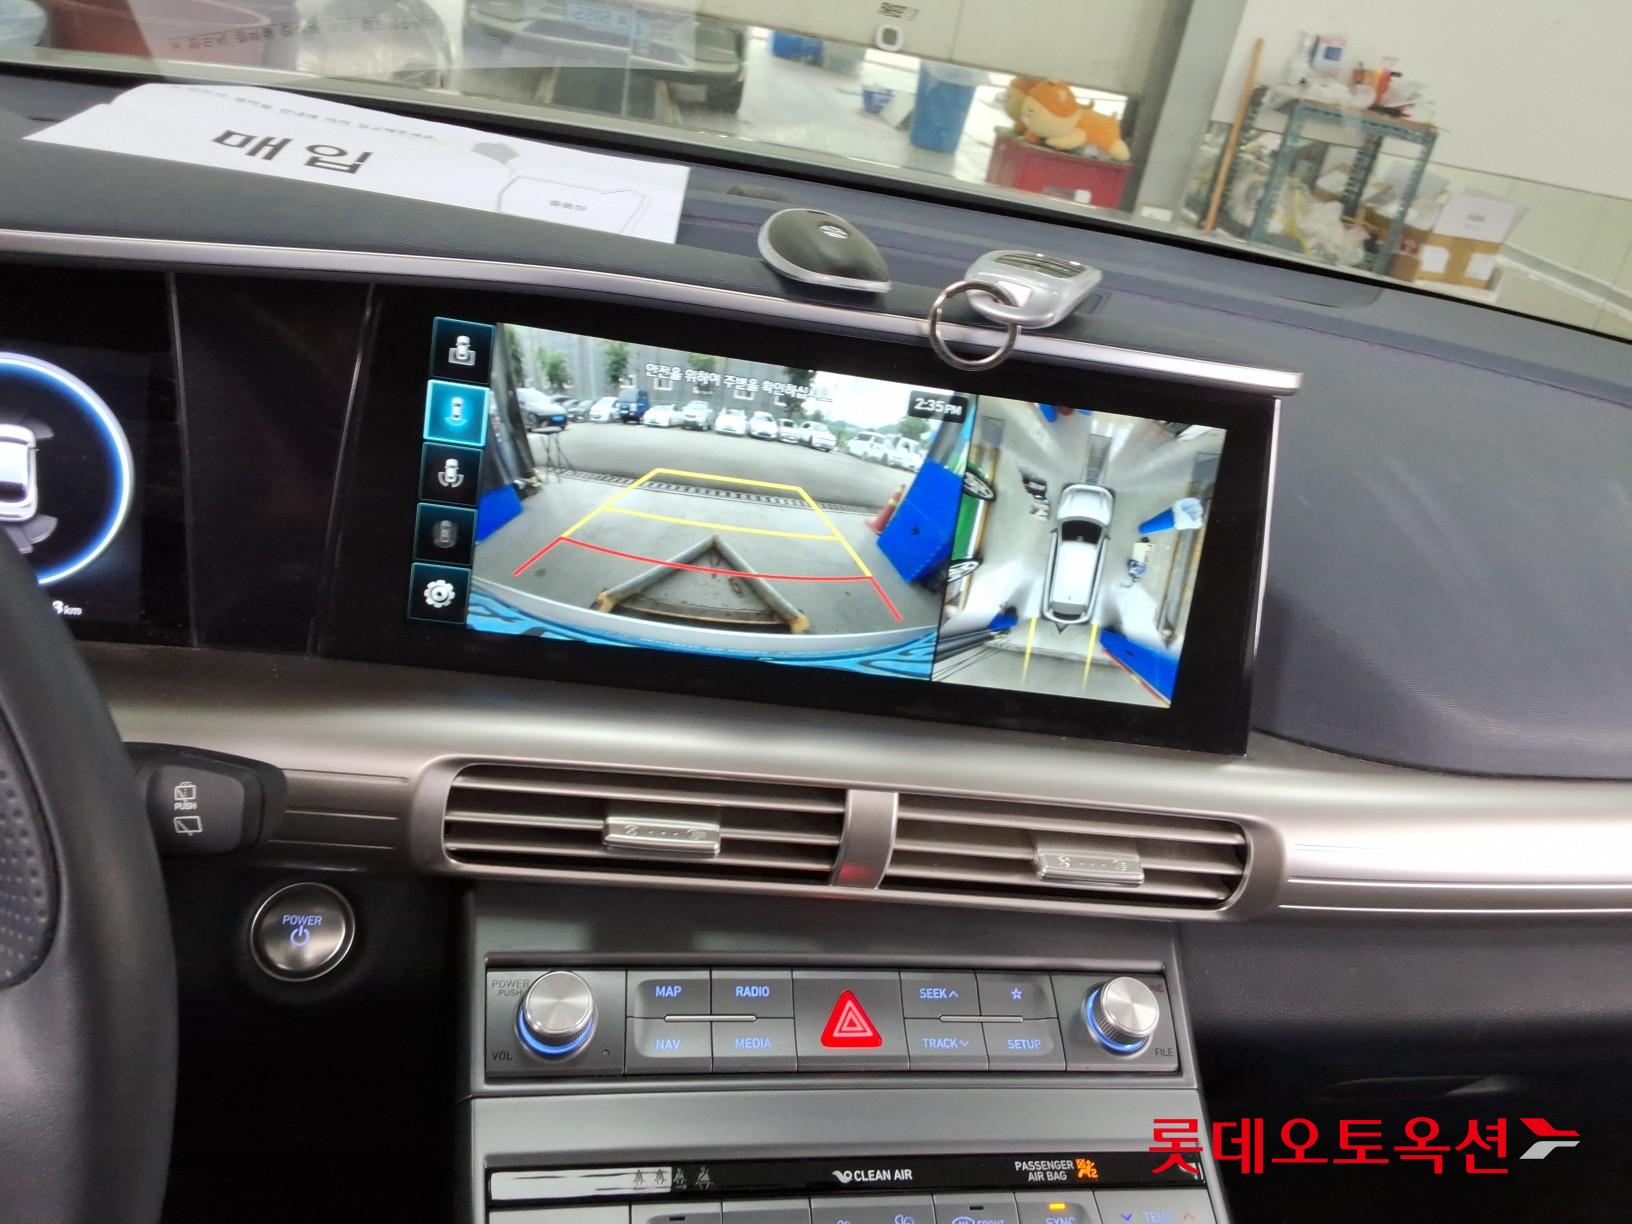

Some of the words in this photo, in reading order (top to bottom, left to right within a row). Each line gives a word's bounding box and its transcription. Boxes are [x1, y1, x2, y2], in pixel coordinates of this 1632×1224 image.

[645, 363, 682, 382] 안전을
[684, 368, 721, 387] 위하여
[723, 374, 761, 392] 주변을
[173, 801, 198, 811] PUSH
[282, 914, 323, 926] POWER
[491, 979, 530, 989] POWER
[497, 988, 523, 998] PUSH
[655, 985, 682, 998] MAP
[735, 985, 771, 998] RADIO
[919, 987, 948, 1000] SEEK
[655, 1038, 681, 1051] NAV
[735, 1038, 772, 1050] MEDIA
[922, 1037, 958, 1049] TRACK
[1007, 1038, 1041, 1050] SETUP
[491, 1050, 513, 1061] VOL
[1154, 1047, 1174, 1057] FILE
[1014, 1159, 1075, 1172] PASSENGER
[853, 1169, 889, 1182] CLEAN
[891, 1169, 913, 1181] AIR
[1028, 1171, 1046, 1182] AIR
[1047, 1170, 1068, 1182] BAG
